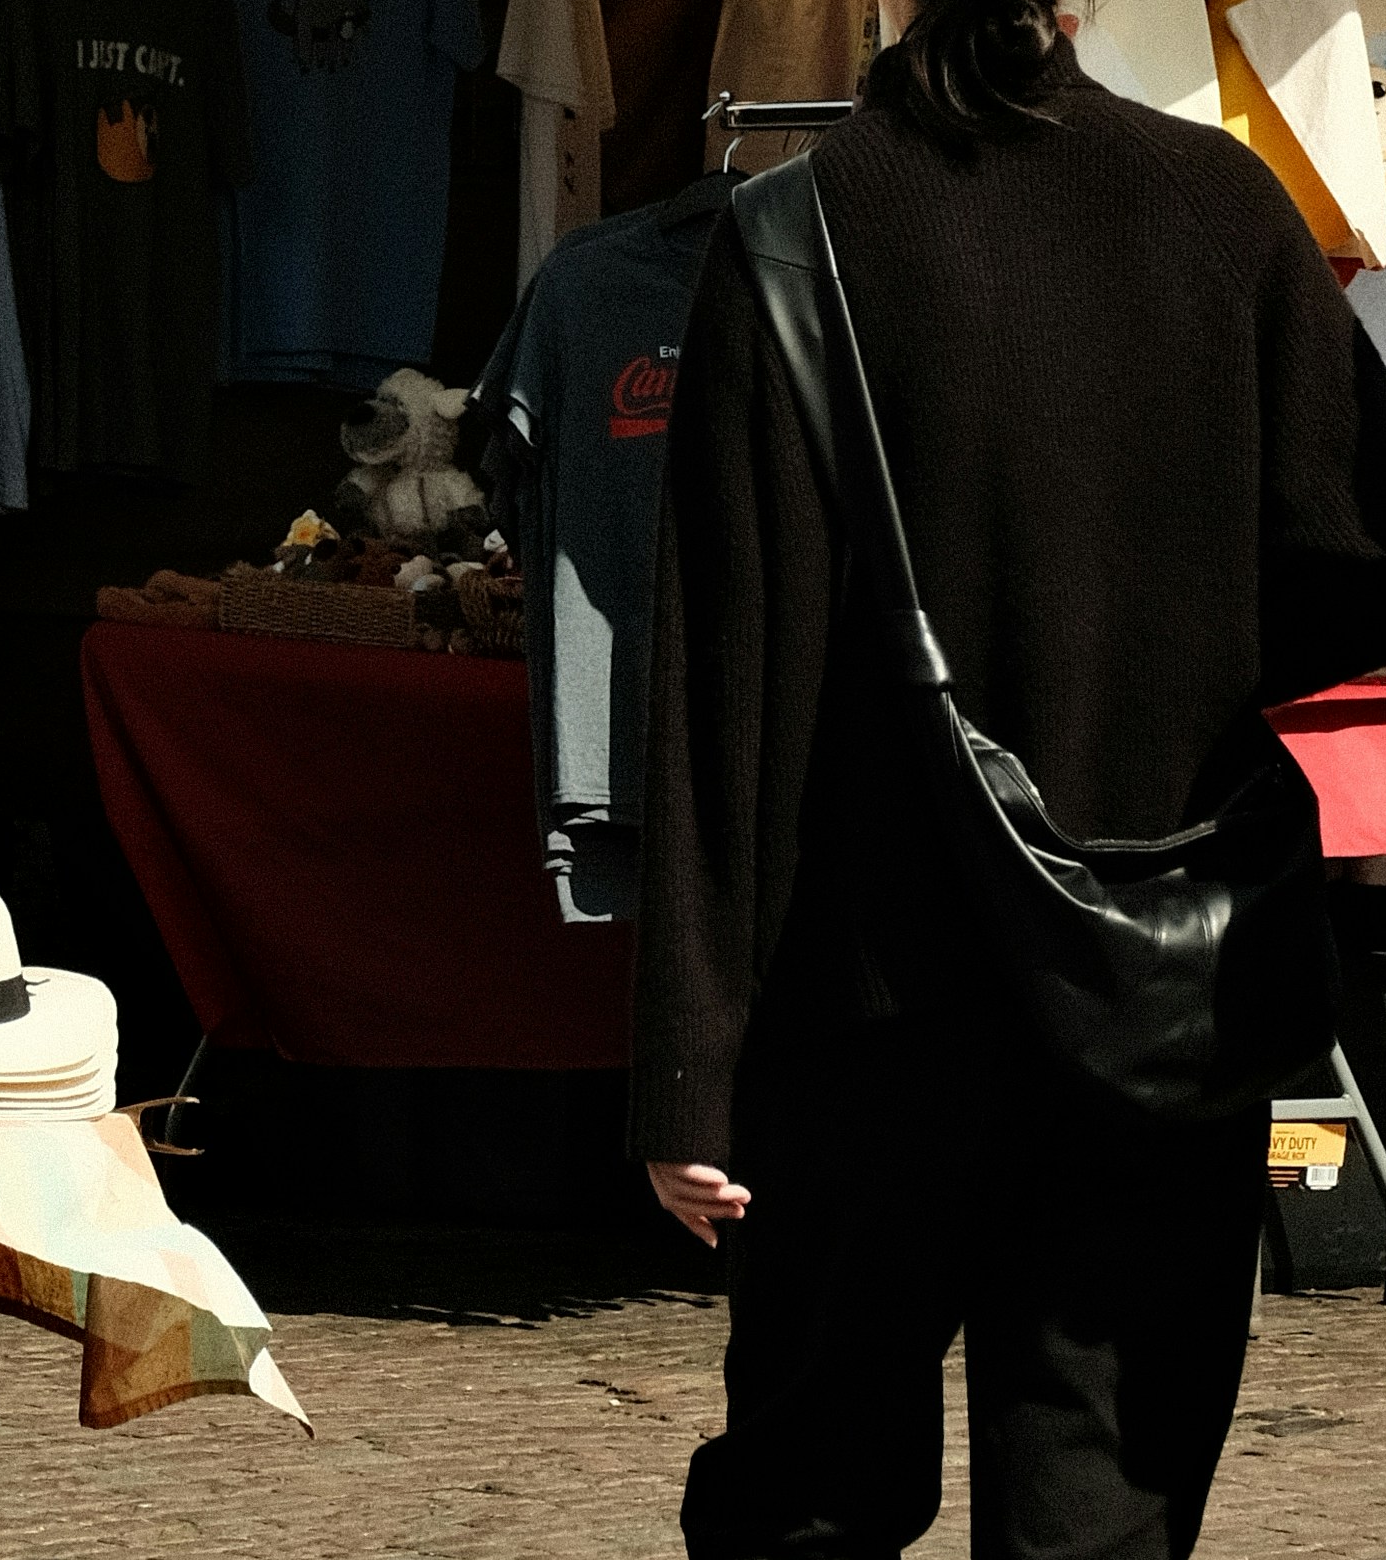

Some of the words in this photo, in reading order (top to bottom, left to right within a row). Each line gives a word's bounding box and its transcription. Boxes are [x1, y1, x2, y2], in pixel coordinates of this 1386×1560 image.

[76, 39, 84, 69] I
[89, 39, 130, 72] JUST
[1289, 1137, 1317, 1151] DUTY
